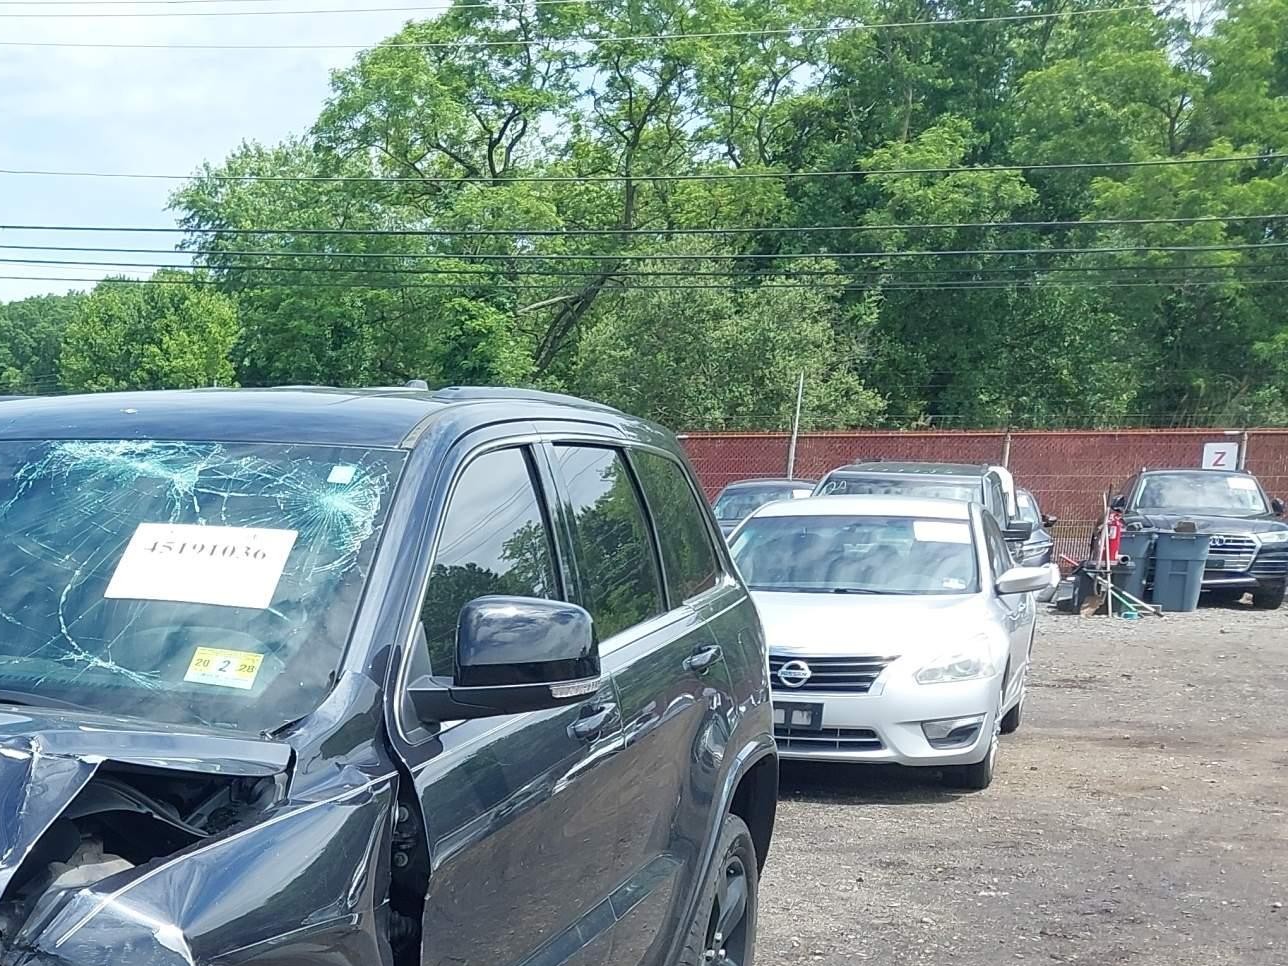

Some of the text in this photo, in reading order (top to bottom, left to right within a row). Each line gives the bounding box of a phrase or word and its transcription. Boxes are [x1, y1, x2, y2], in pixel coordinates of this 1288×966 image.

[1212, 451, 1226, 466] Z
[144, 541, 266, 560] 45191036
[218, 660, 231, 672] 2
